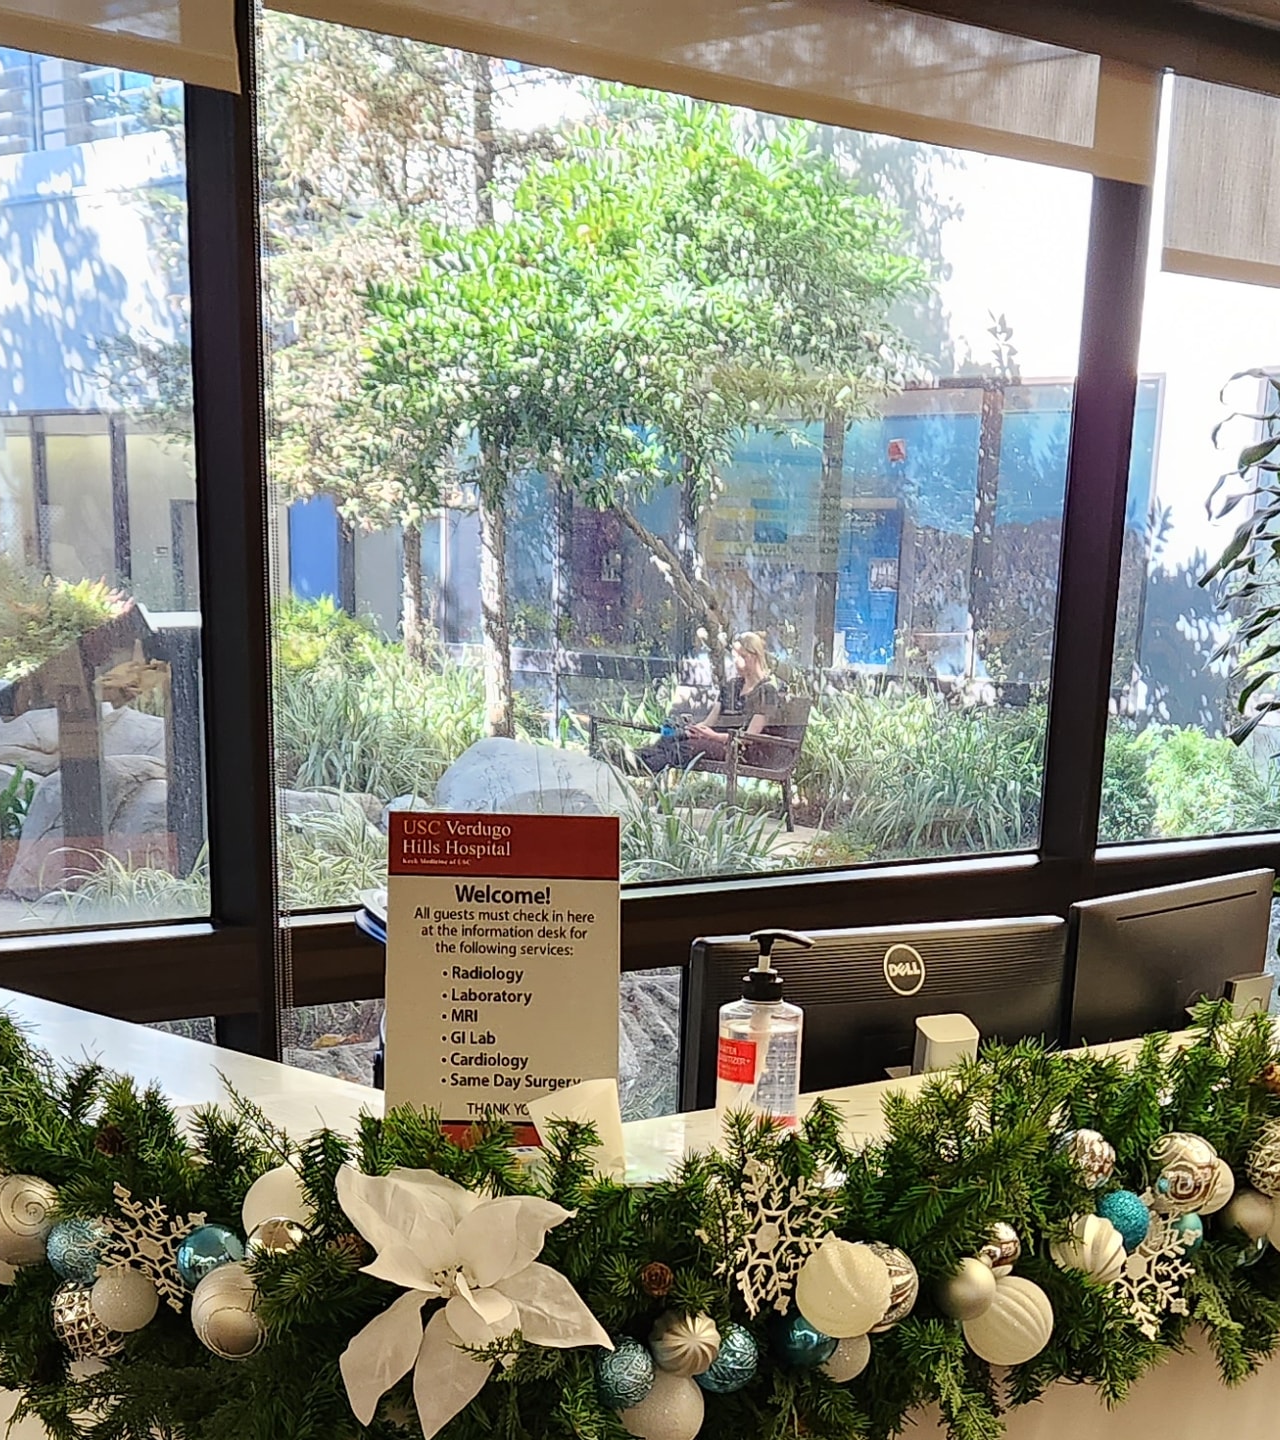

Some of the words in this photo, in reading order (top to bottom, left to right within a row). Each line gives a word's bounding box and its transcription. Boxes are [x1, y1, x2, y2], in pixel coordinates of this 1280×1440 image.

[403, 820, 441, 836] USC
[446, 820, 512, 840] Verdugo
[403, 839, 441, 856] Hills
[446, 839, 511, 858] Hospital
[455, 884, 551, 905] Welcome!
[414, 907, 430, 920] All
[433, 909, 475, 923] guests
[478, 909, 510, 921] must
[512, 908, 549, 922] check
[552, 910, 563, 922] in
[567, 909, 595, 923] here
[421, 925, 434, 936] at
[437, 924, 458, 936] the
[461, 924, 534, 938] information
[537, 925, 566, 939] desk
[569, 925, 588, 939] for
[435, 941, 456, 953] the
[459, 940, 517, 958] following
[520, 943, 574, 956] services:
[451, 965, 524, 984] Radiology
[888, 961, 921, 977] DELL
[451, 988, 532, 1006] Laboratory
[451, 1009, 479, 1023] MRI
[450, 1031, 466, 1045] GI
[470, 1030, 496, 1045] Lab
[450, 1052, 529, 1070] Cardiology
[450, 1073, 490, 1087] Same
[493, 1073, 522, 1090] Day
[467, 1102, 510, 1116] THANK
